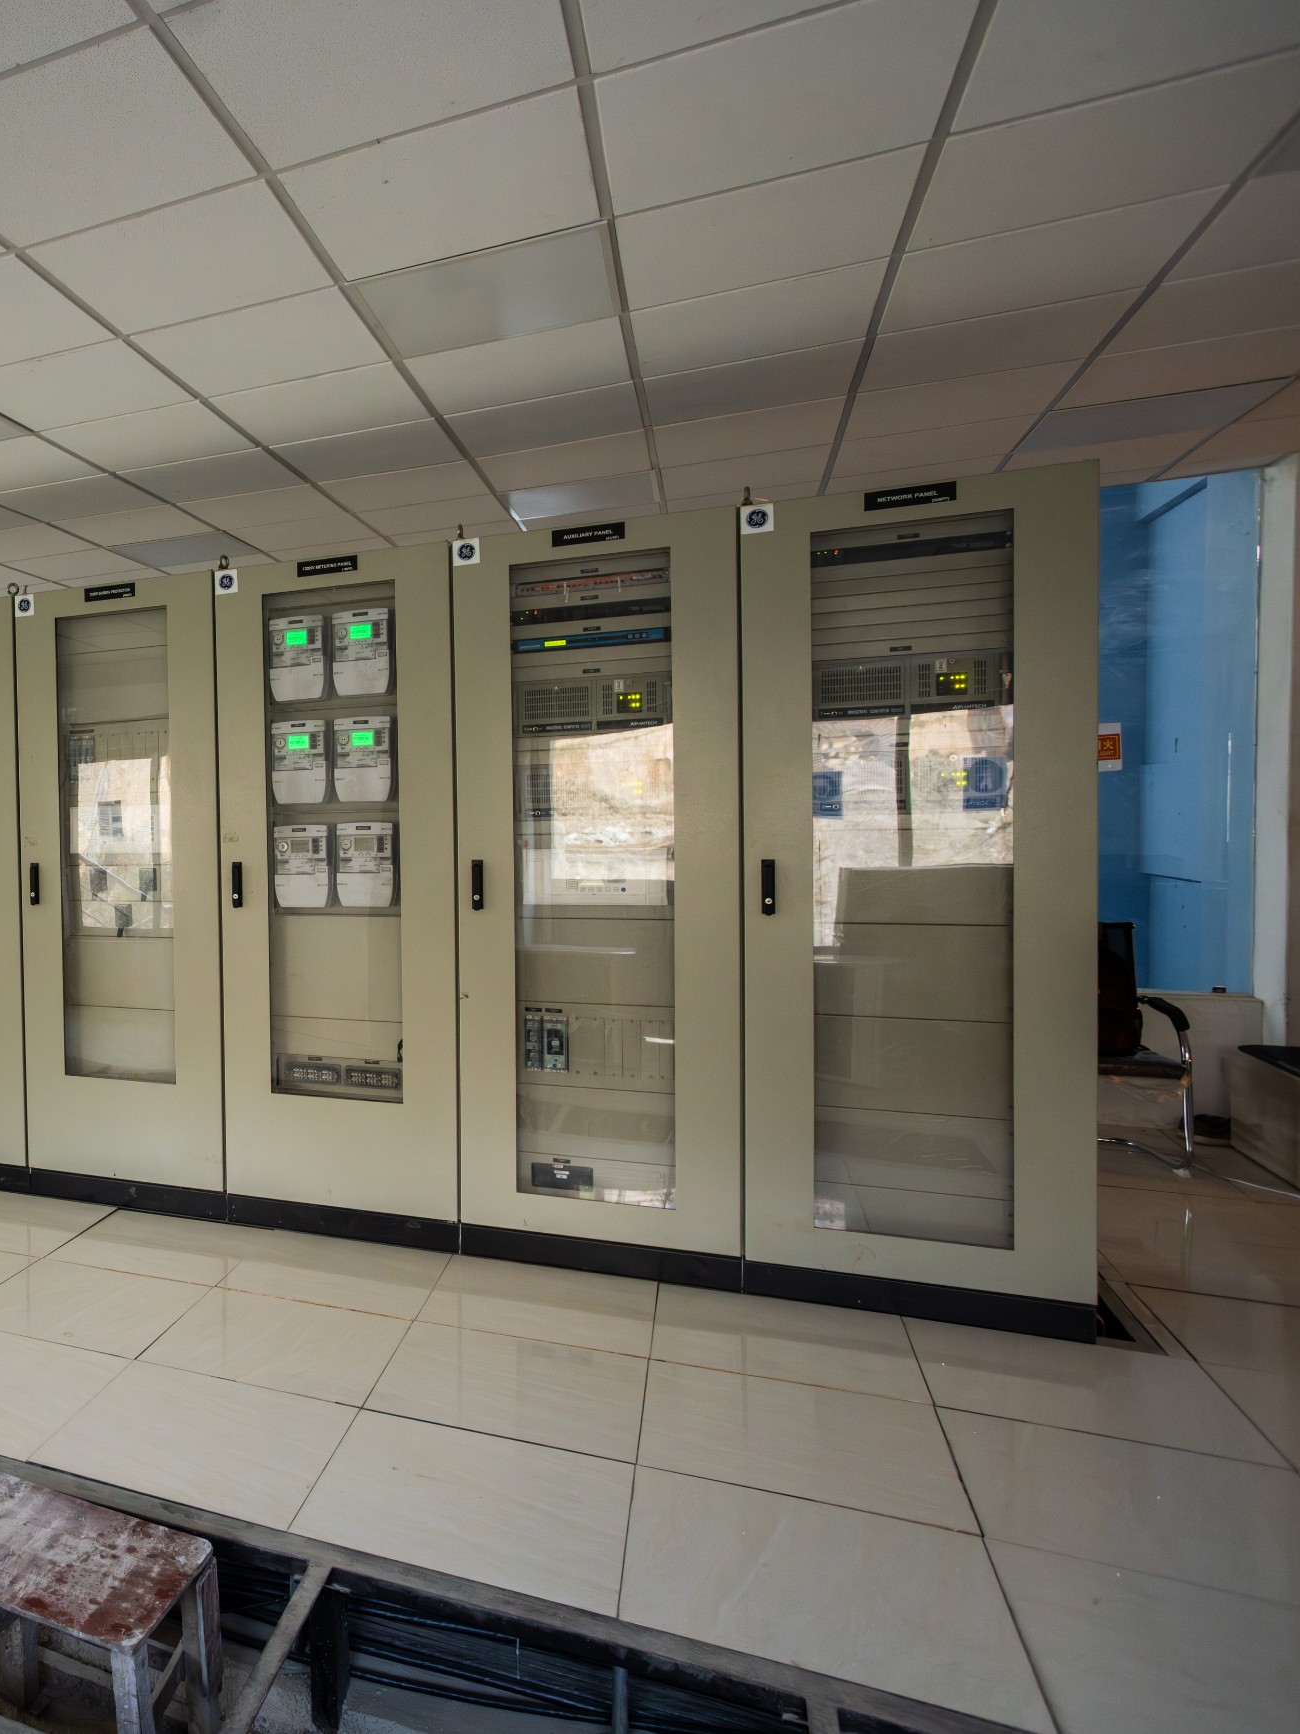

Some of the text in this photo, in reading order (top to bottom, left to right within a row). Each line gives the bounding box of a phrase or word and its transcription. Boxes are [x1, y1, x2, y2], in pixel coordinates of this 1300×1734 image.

[876, 490, 939, 504] NETWORK PANEL
[563, 529, 614, 541] AUXILIARY PANEL
[315, 563, 337, 571] METERING
[952, 703, 987, 711] ADVANTECH
